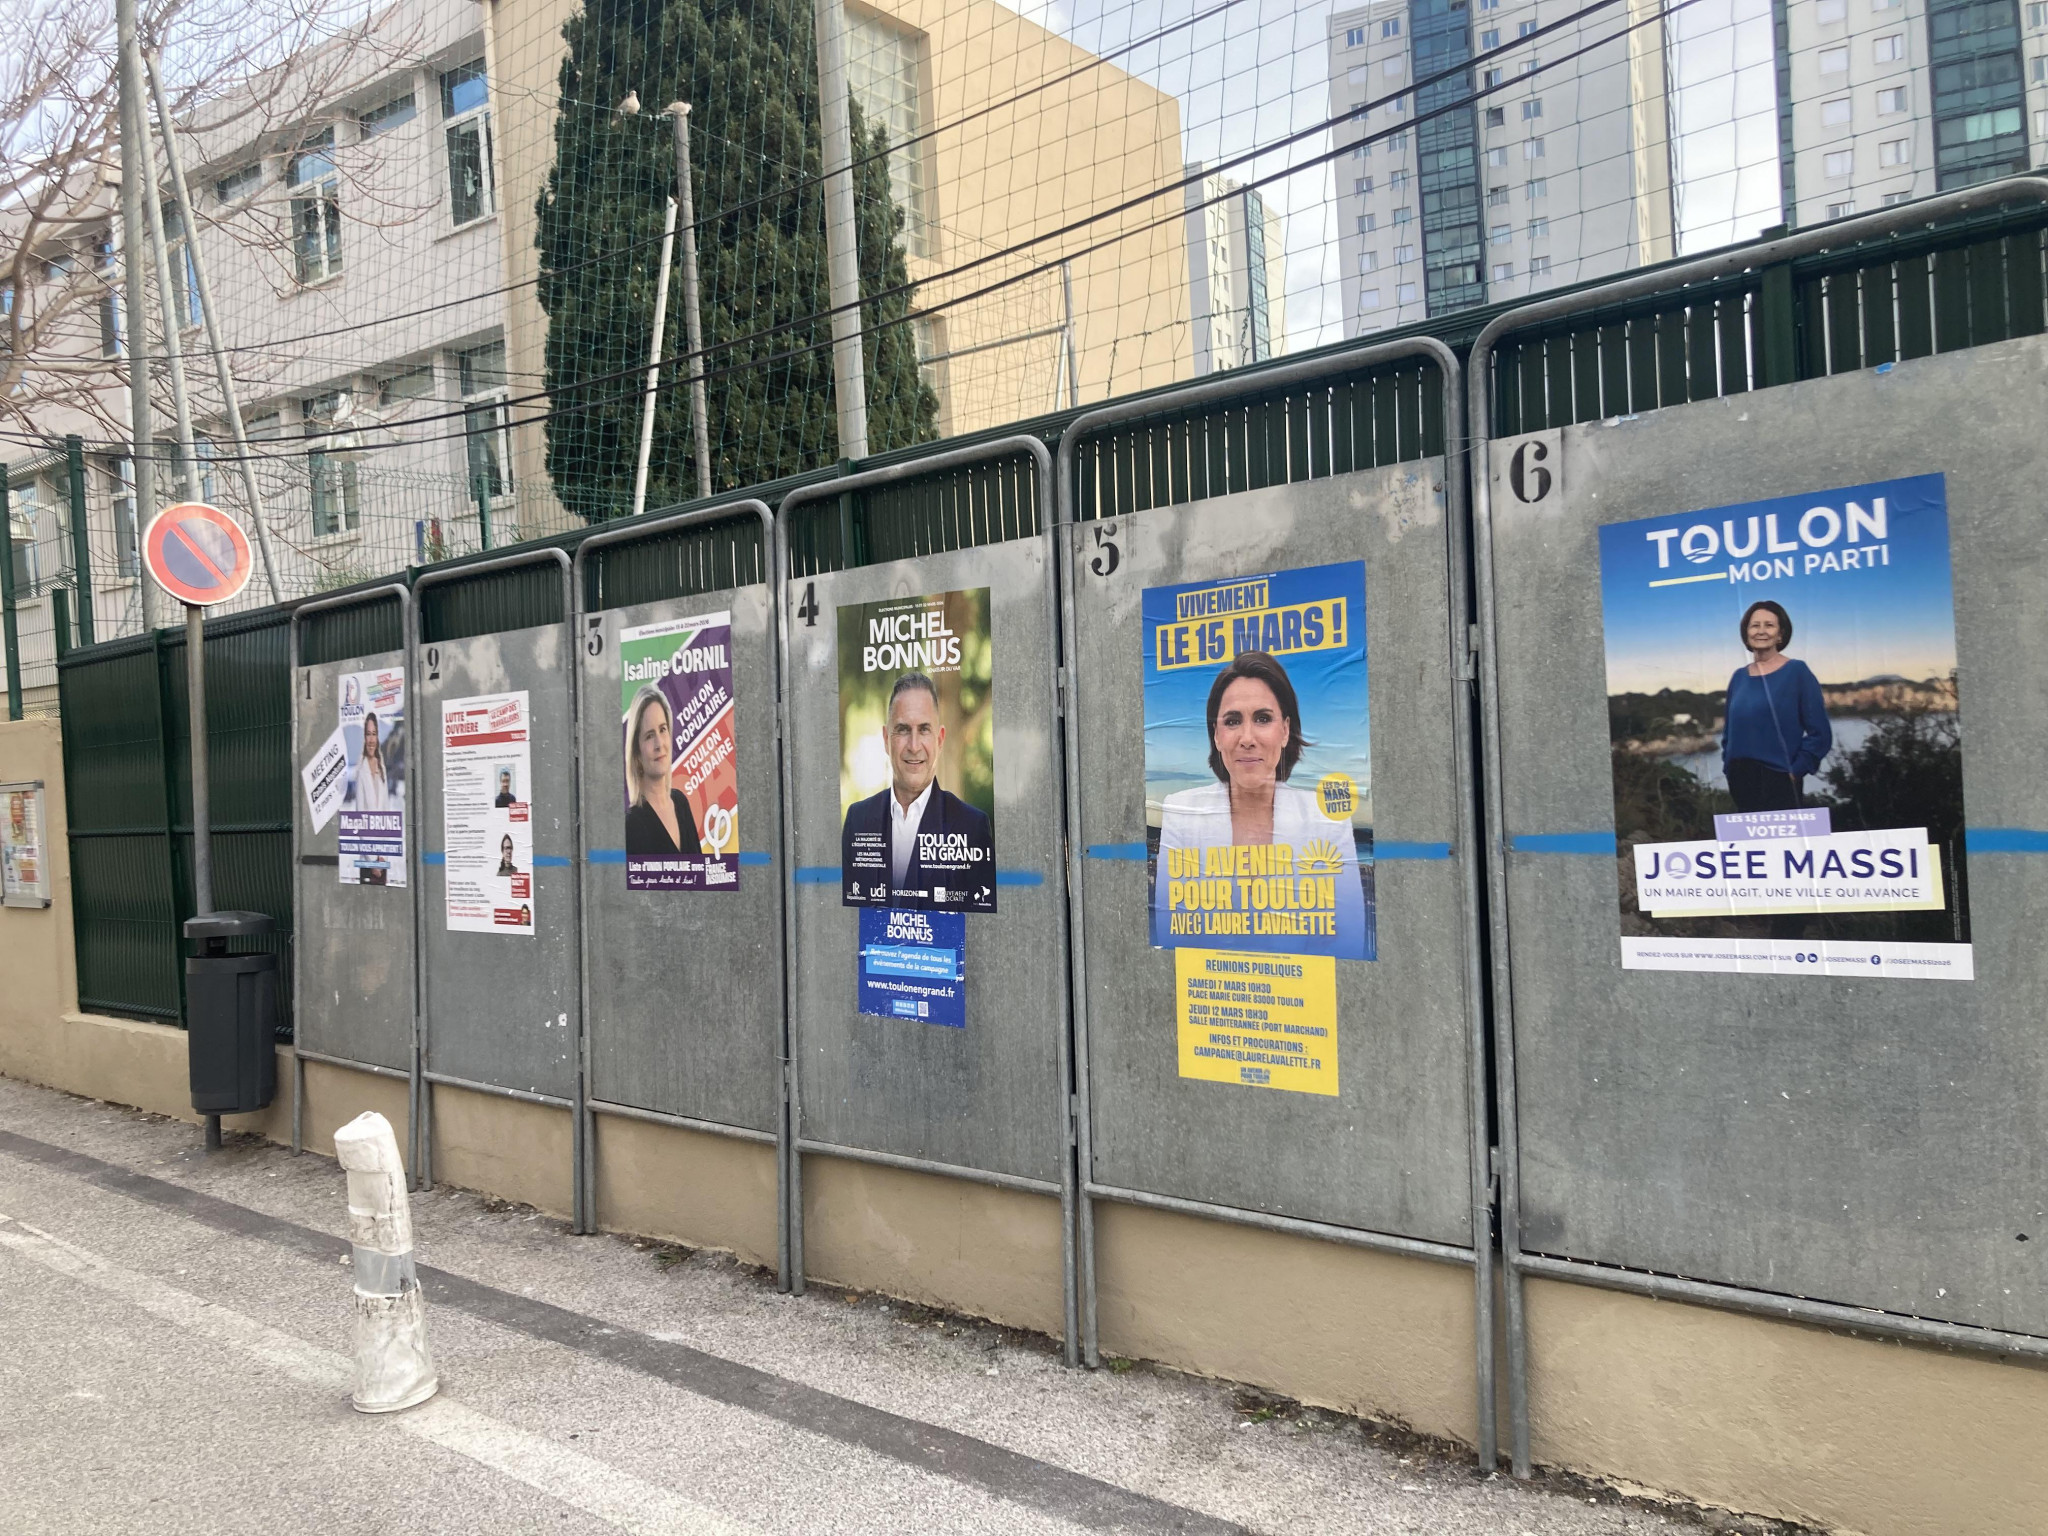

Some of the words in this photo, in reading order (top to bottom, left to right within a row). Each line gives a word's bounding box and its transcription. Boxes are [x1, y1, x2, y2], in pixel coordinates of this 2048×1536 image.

[1510, 440, 1551, 503] 6
[1646, 497, 1887, 568] TOULON
[1091, 523, 1120, 576] 5
[1729, 557, 1794, 584] MON
[1804, 544, 1889, 575] PARTI
[798, 582, 819, 626] 4
[1178, 583, 1266, 618] VIVEMENT
[588, 617, 602, 656] 3
[869, 610, 953, 644] MICHEL
[1160, 626, 1189, 666] LE
[1196, 621, 1226, 661] 15
[1233, 606, 1323, 656] MARS
[1332, 602, 1342, 644] !
[428, 648, 440, 680] 2
[624, 657, 669, 682] Isaline
[672, 644, 728, 675] CORNIL
[864, 637, 961, 672] BONNUS
[306, 670, 312, 700] 1
[341, 706, 364, 716] TOULON
[676, 680, 714, 726] TOULON
[446, 712, 464, 723] LUTTE
[446, 720, 478, 734] OUVRIÈRE
[676, 686, 728, 750] POPULAIRE
[683, 728, 722, 774] TOULON
[311, 744, 339, 782] MEETING
[684, 737, 733, 796] SOLIDAIRE
[1324, 788, 1350, 801] MARS
[1326, 800, 1352, 813] VOTEZ
[341, 814, 368, 834] Magali
[370, 815, 401, 830] BRUNEL
[1726, 815, 1743, 823] LES
[1745, 815, 1757, 823] 15
[1760, 814, 1771, 822] ET
[1789, 813, 1816, 821] MARS
[918, 834, 967, 847] TOULON
[1746, 825, 1797, 837] VOTEZ
[920, 848, 936, 860] EN
[939, 848, 982, 861] GRAND
[986, 848, 990, 861] !
[1168, 847, 1200, 878] UN
[1205, 844, 1294, 877] AVENIR
[1644, 843, 1768, 880] JOSÉE
[1784, 848, 1918, 879] MASSI
[629, 862, 641, 871] Liste
[870, 883, 886, 897] udi
[1169, 880, 1233, 911] POUR
[1237, 877, 1335, 910] TOULON
[1644, 888, 1663, 897] UN
[1665, 888, 1702, 897] MAIRE
[1706, 888, 1728, 898] QUI
[1731, 888, 1761, 898] AGIT,
[1766, 888, 1793, 897] UNE
[1796, 888, 1832, 897] VILLE
[1836, 888, 1860, 898] QUI
[1864, 888, 1919, 898] AVANCE
[890, 912, 929, 927] MICHEL
[1170, 912, 1201, 935] AVEC
[1205, 912, 1250, 935] LAURE
[1254, 912, 1336, 935] LAVALETTE
[887, 925, 933, 942] BONNUS
[870, 949, 897, 957] Retrouvez
[898, 950, 921, 960] l'agenda
[930, 954, 942, 962] tous
[943, 956, 952, 964] les
[906, 962, 913, 970] de
[920, 964, 949, 975] campagne
[1252, 962, 1302, 977] PUBLIQUES
[868, 980, 955, 998] www.toulonengrand.fr
[1188, 978, 1216, 990] SAMEDI
[1218, 980, 1223, 990] 7
[1224, 981, 1246, 992] MARS
[1248, 982, 1271, 994] 10H30
[1188, 990, 1208, 1000] PLACE
[1210, 992, 1230, 1001] MARIE
[1232, 994, 1252, 1003] CURIE
[1253, 995, 1275, 1005] 83000
[1278, 996, 1304, 1007] TOULON
[1189, 1004, 1210, 1015] JEUDI
[1212, 1006, 1219, 1016] 12
[1221, 1007, 1243, 1018] MARS
[1245, 1009, 1268, 1020] 18H30
[1189, 1016, 1208, 1026] SALLE
[1262, 1021, 1282, 1032] (PORT
[1284, 1023, 1328, 1038] MARCHAND)
[1209, 1033, 1231, 1045] INFOS
[1233, 1036, 1241, 1045] ET
[1243, 1037, 1303, 1053] PROCURATIONS
[1194, 1046, 1321, 1070] CAMPAGNE@LAURELAVALETTE.FR
